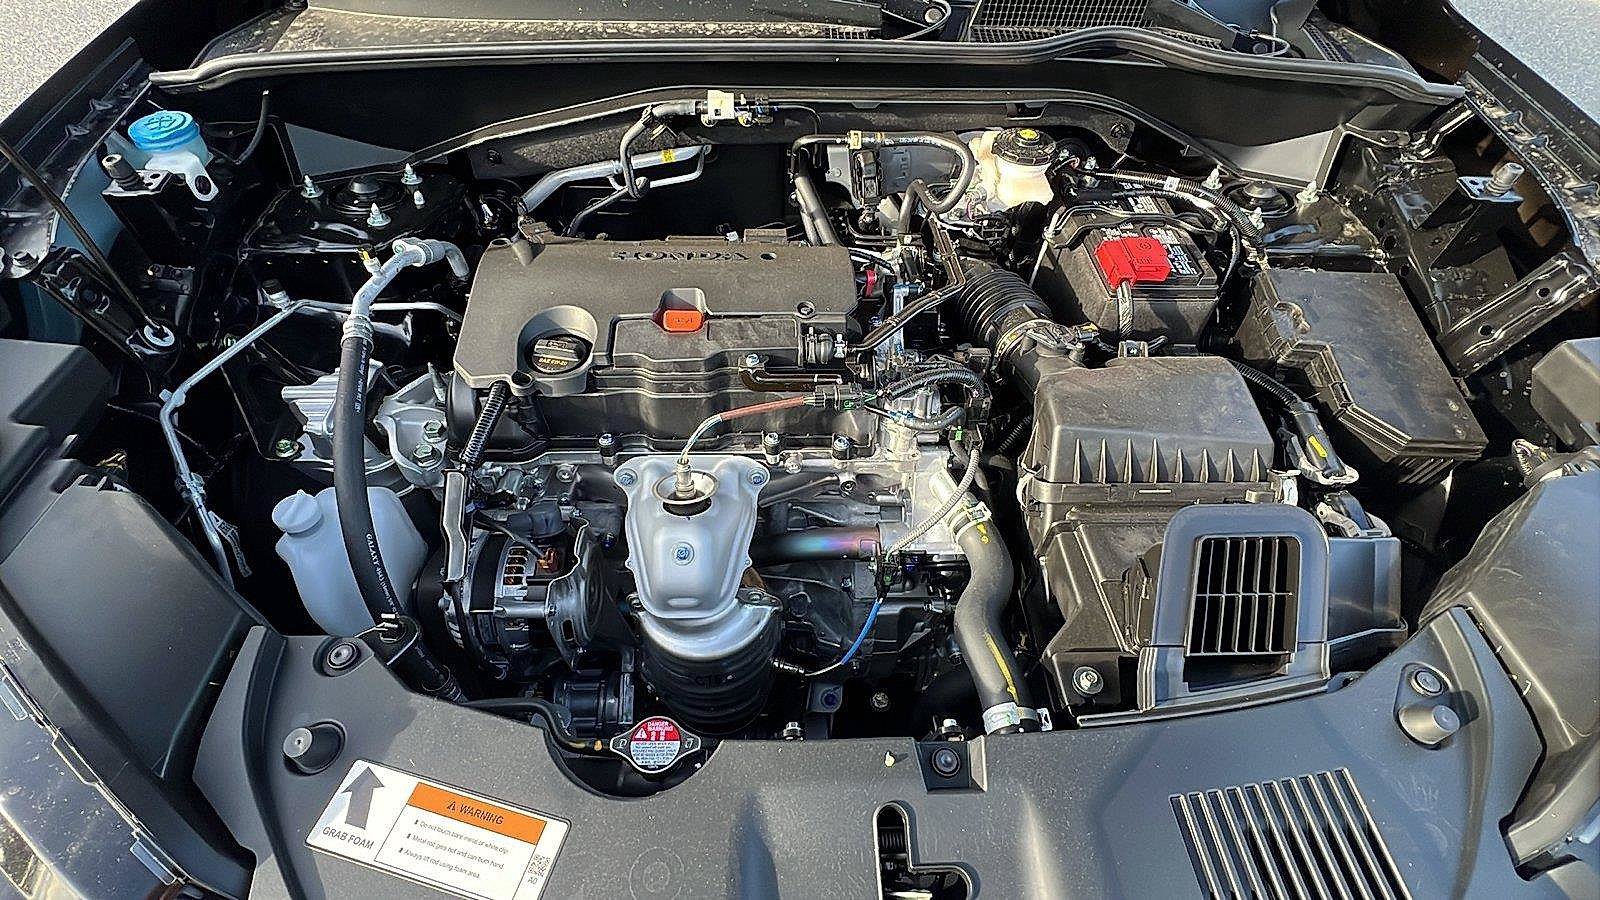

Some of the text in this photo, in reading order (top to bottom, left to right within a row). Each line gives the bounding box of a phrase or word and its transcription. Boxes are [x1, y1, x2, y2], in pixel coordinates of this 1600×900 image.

[612, 251, 751, 261] HONDA
[366, 533, 380, 566] GALAXY
[459, 803, 505, 825] WARNING
[322, 826, 374, 850] GRAB FOAM
